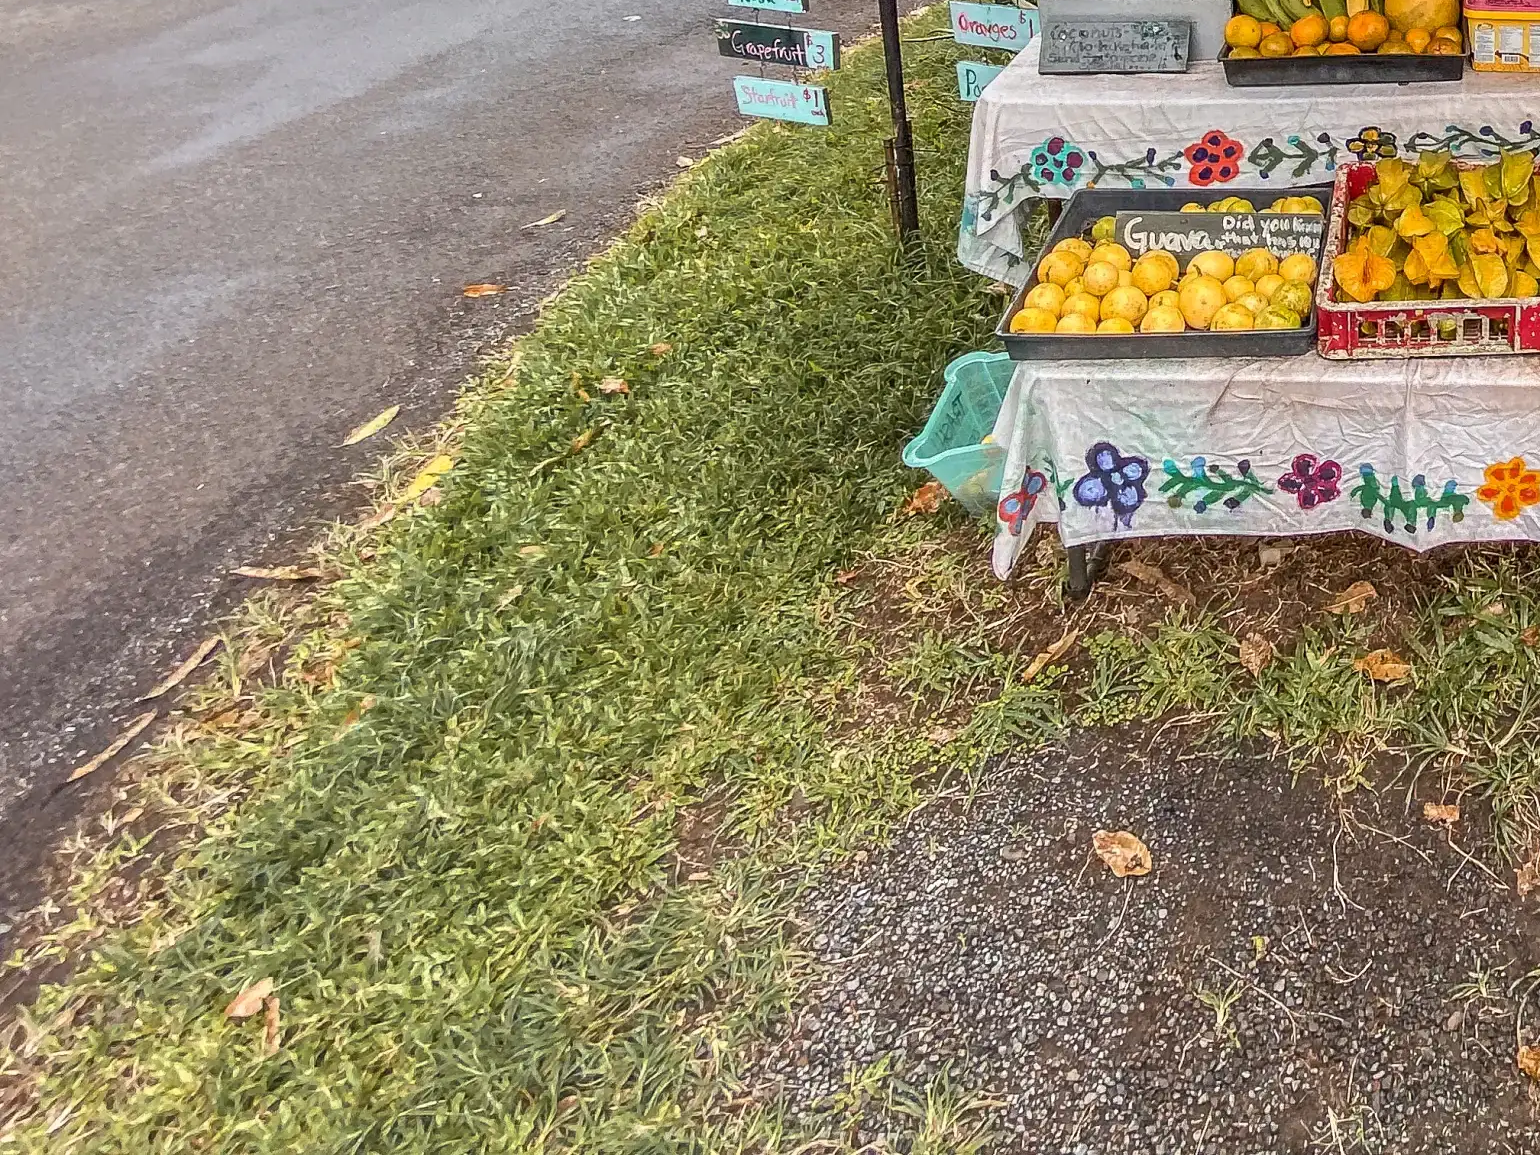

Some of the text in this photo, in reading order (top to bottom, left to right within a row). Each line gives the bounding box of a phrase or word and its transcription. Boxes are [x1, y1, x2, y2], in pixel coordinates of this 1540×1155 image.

[958, 12, 1018, 43] Oranges
[731, 30, 806, 66] Grapefruit
[741, 84, 799, 109] Starfruit
[1123, 216, 1216, 254] Guava
[1222, 215, 1256, 231] Did
[1260, 218, 1290, 238] you
